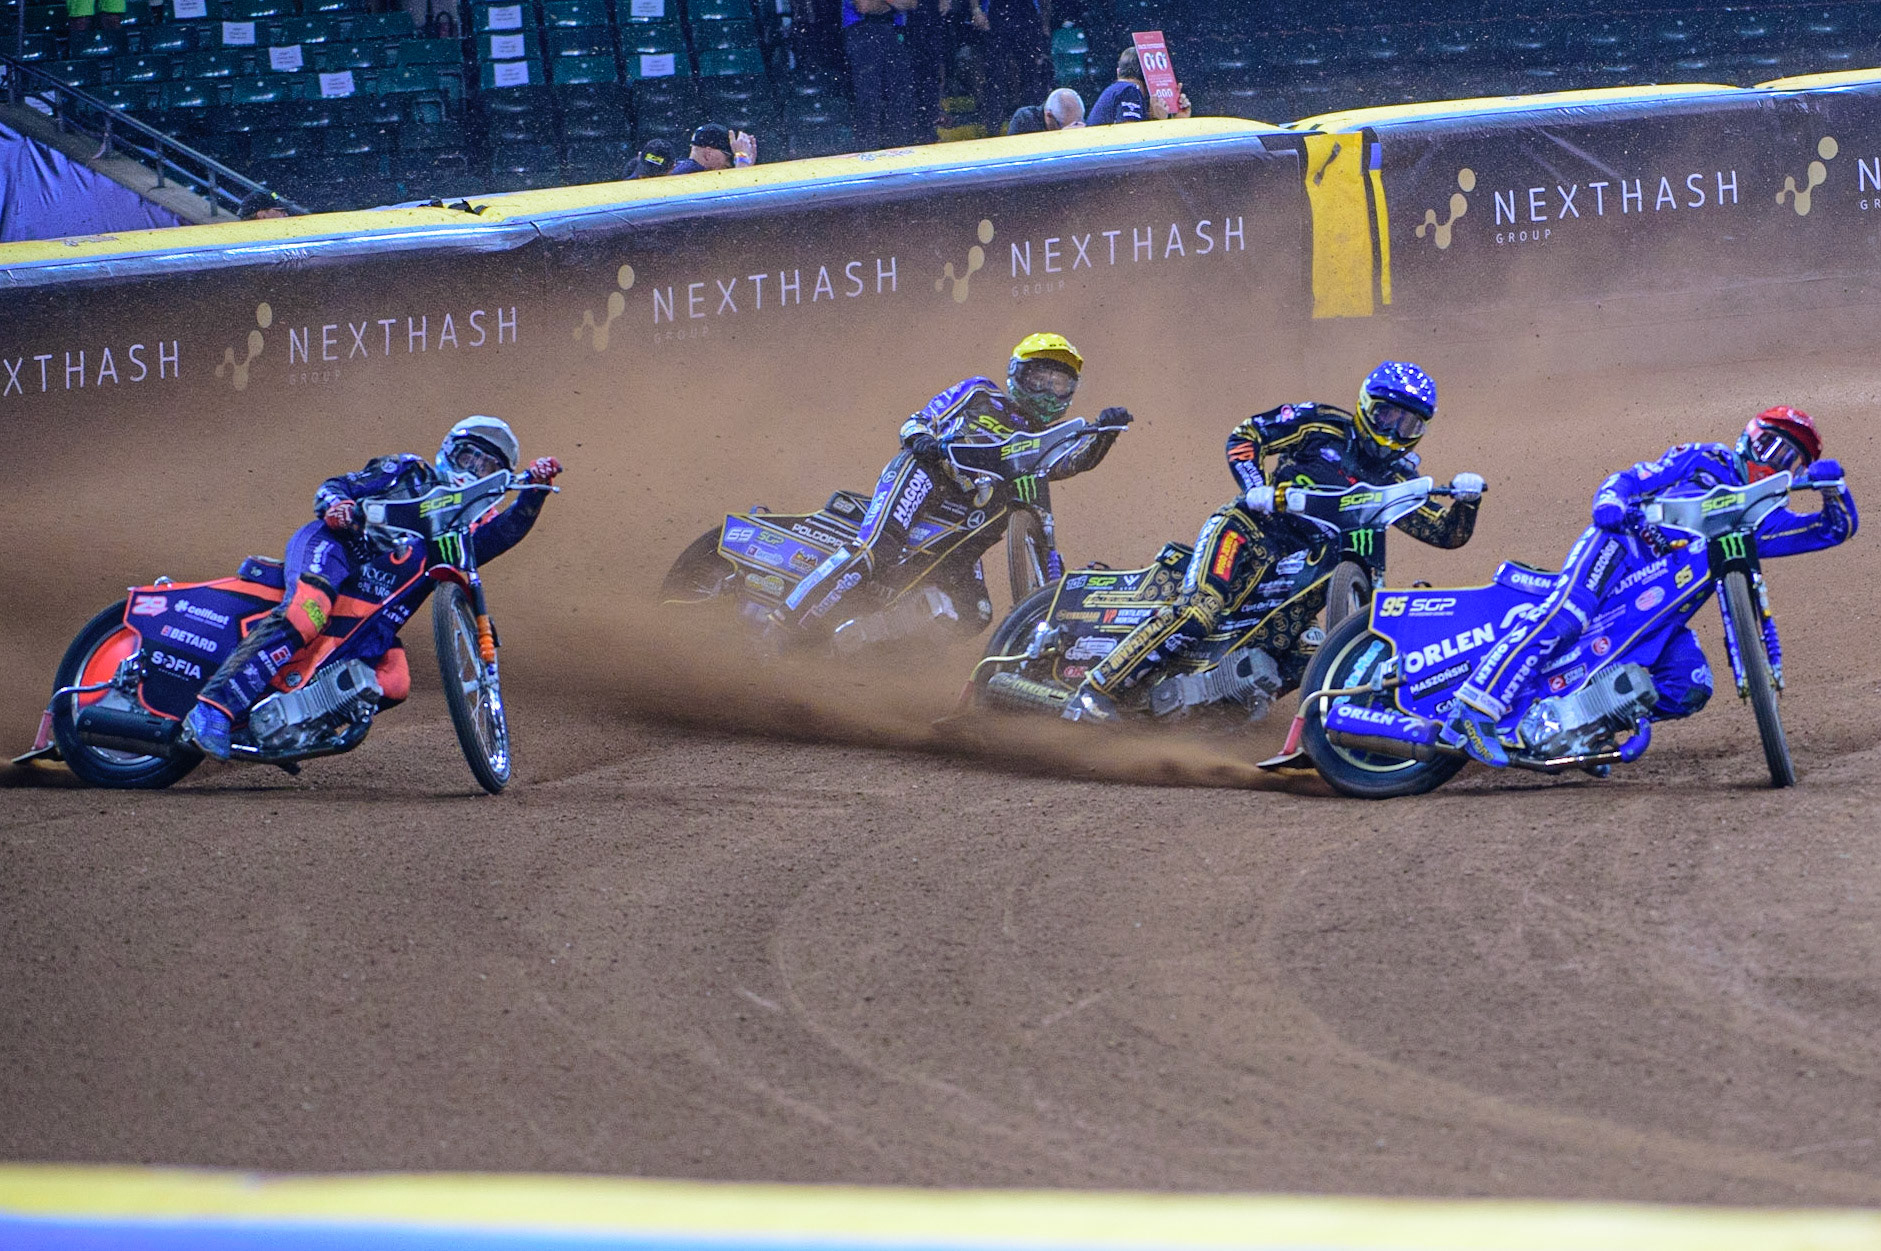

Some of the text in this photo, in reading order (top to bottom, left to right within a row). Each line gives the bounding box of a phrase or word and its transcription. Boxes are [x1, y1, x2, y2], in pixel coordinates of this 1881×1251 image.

[1494, 170, 1738, 225] NEXTHASH
[1011, 216, 1245, 278] NEXTHASH
[1496, 229, 1551, 244] GROUP
[653, 257, 897, 324] NEXTHASH
[1012, 280, 1065, 297] GROUP
[289, 307, 517, 364] NEXTHASH
[3, 340, 179, 397] XTHASH
[1001, 440, 1032, 457] SGP
[420, 496, 456, 515] SGP
[893, 468, 928, 523] HAGON
[1339, 492, 1374, 506] SGP
[1701, 496, 1737, 511] SGP
[726, 527, 756, 542] 69
[1088, 577, 1117, 587] SGP
[1510, 573, 1552, 589] ORLEN
[1674, 563, 1694, 589] 95
[1379, 596, 1409, 618] 95
[1410, 598, 1457, 612] SGP
[1103, 609, 1118, 624] VP
[169, 627, 218, 653] BETARD
[1404, 622, 1495, 674] ORLEN
[1474, 642, 1509, 686] ORLEN
[1409, 661, 1470, 695] MASZOŃSKI
[1500, 655, 1539, 705] ORLEN
[1337, 705, 1395, 726] ORLEN
